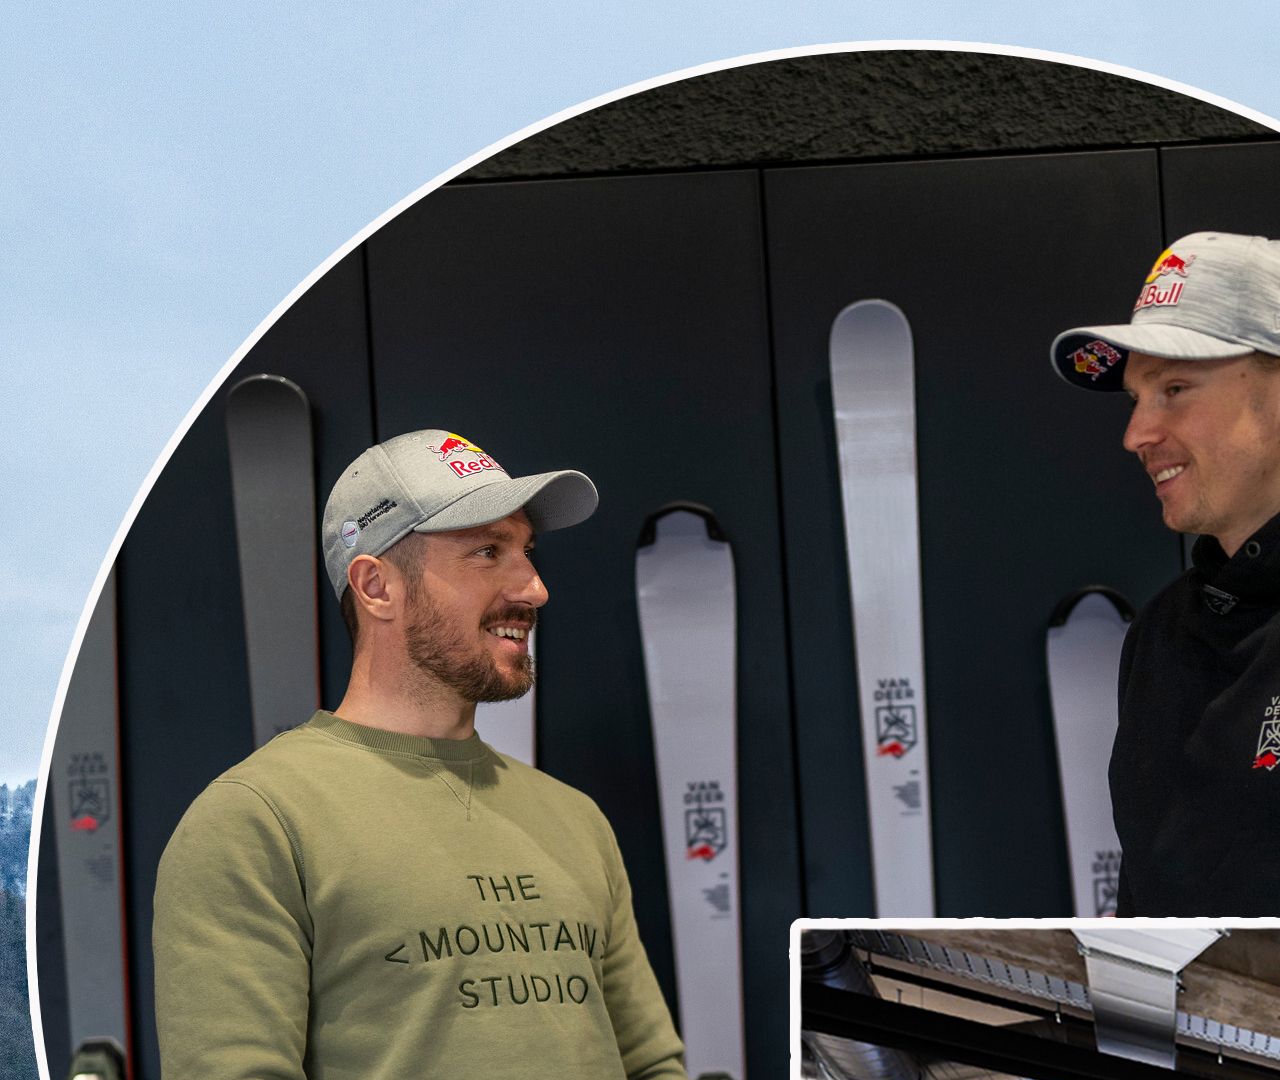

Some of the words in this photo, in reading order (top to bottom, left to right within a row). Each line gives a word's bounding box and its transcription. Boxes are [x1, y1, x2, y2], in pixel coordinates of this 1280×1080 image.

[1144, 282, 1183, 305] Bull
[449, 453, 493, 477] Red
[876, 678, 910, 689] VAN
[873, 688, 915, 702] DEER
[70, 752, 104, 763] VAN
[687, 781, 720, 791] VAN
[683, 792, 724, 804] DEER
[1092, 861, 1120, 874] DEE
[467, 874, 541, 902] THE
[458, 974, 589, 1009] STUDIO
